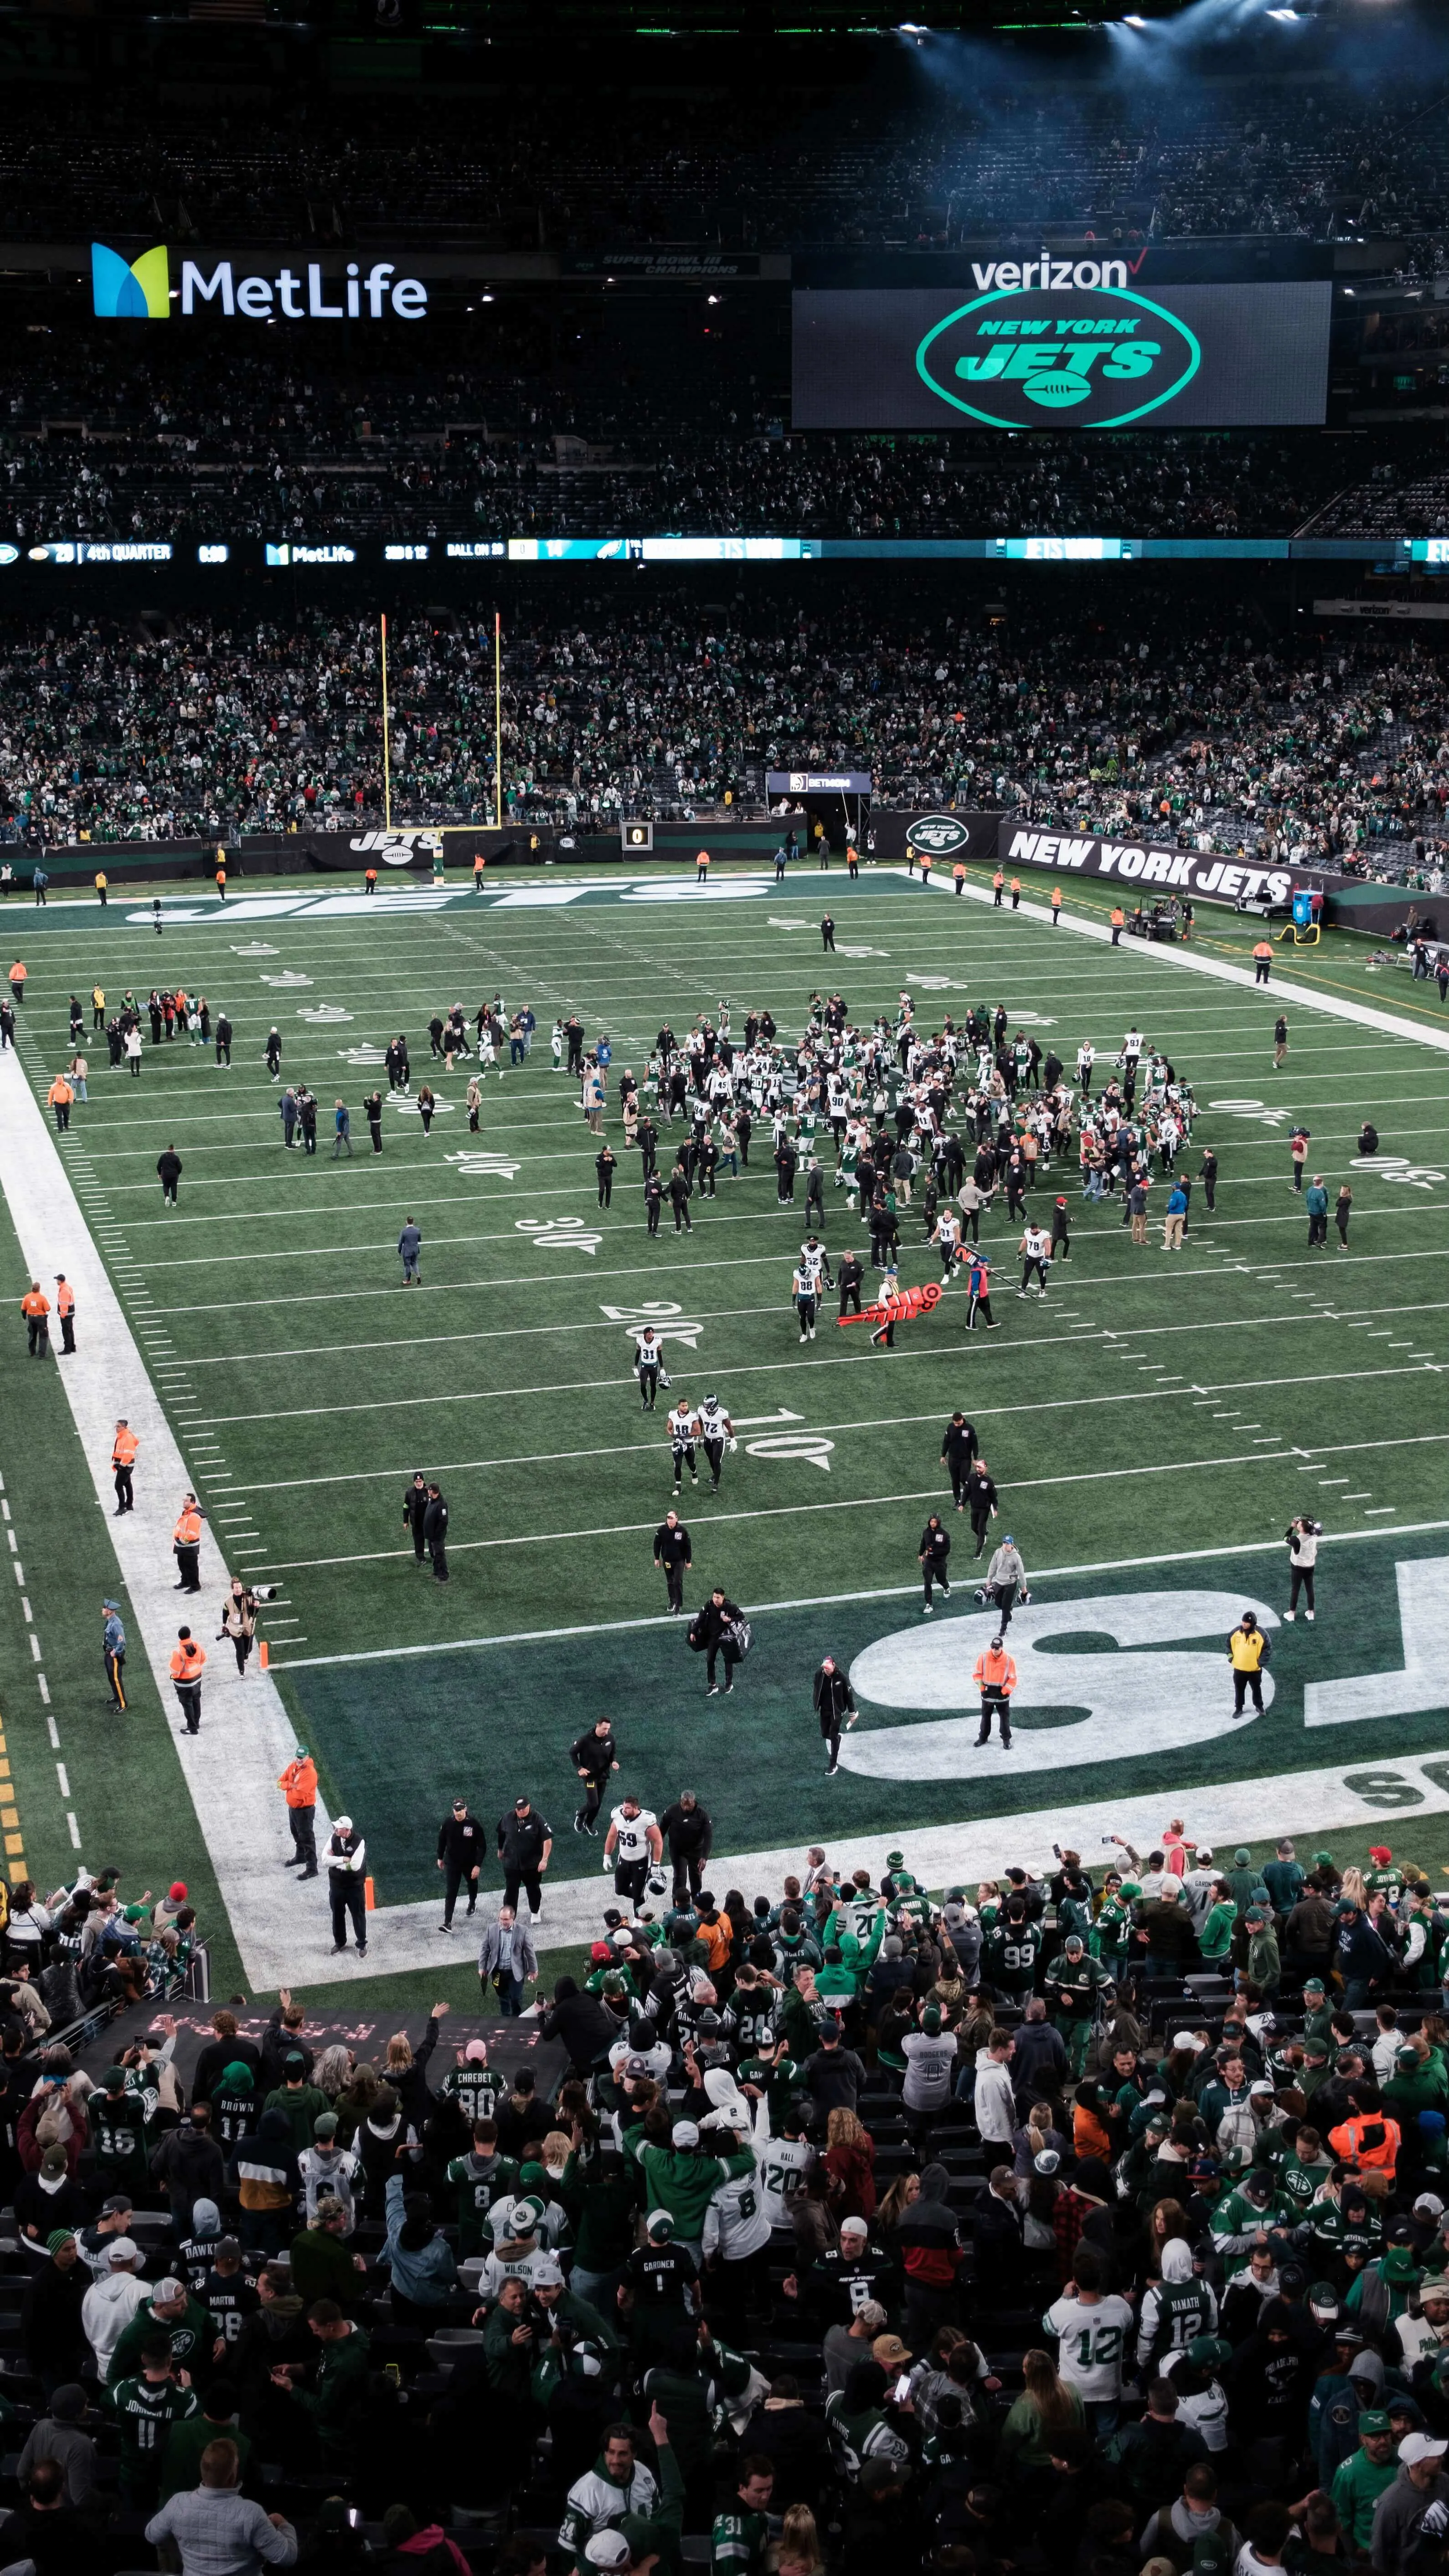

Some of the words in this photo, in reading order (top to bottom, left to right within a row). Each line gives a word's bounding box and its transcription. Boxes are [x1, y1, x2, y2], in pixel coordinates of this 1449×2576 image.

[603, 256, 653, 264] SUPER
[656, 256, 701, 264] BOWL
[703, 256, 722, 264] III
[645, 265, 738, 274] CHAMPIONS
[971, 253, 1127, 290] verizon
[182, 261, 427, 318] MetLife
[977, 320, 1052, 335] NEW
[1055, 319, 1140, 335] YORK
[955, 341, 1161, 380] JETS
[87, 546, 110, 560] 4th
[113, 545, 171, 560] QUARTER
[293, 547, 354, 562] MetLife
[448, 544, 473, 556] BALL
[350, 831, 444, 851] JETS
[632, 828, 643, 844] 0
[915, 830, 960, 841] JETS
[1008, 831, 1096, 867] NEW
[1098, 843, 1197, 886] YORK
[1196, 862, 1291, 902] JETS
[125, 880, 777, 923] JETS
[258, 974, 314, 987] 20
[297, 1007, 354, 1022] 30
[832, 1096, 844, 1106] 90
[443, 1151, 521, 1174] 40
[842, 1149, 856, 1161] 77
[1350, 1156, 1447, 1182] 30
[515, 1217, 603, 1247] 30
[1028, 1241, 1039, 1251] 78
[955, 1247, 973, 1262] 2
[800, 1281, 812, 1291] 88
[598, 1301, 704, 1339] 20
[643, 1349, 654, 1359] 31
[704, 1422, 717, 1434] 72
[618, 1830, 637, 1848] 69
[900, 1900, 922, 1910] NAMATH
[1004, 1944, 1034, 1970] 99
[458, 2073, 491, 2084] CHREBET
[221, 2100, 254, 2112] BROWN
[459, 2088, 495, 2119] 80
[730, 2107, 738, 2117] 2
[221, 2117, 247, 2142] 11
[100, 2127, 135, 2154] 16
[780, 2152, 794, 2163] HALL
[767, 2164, 803, 2195] 20
[474, 2185, 490, 2209] 8
[738, 2188, 757, 2220] 8
[504, 2264, 532, 2276] WILSON
[644, 2260, 675, 2272] GARDNER
[656, 2274, 664, 2292] 1
[210, 2296, 235, 2306] MARTIN
[850, 2282, 870, 2315] 8
[1171, 2296, 1200, 2312] NAMATH
[1170, 2313, 1202, 2348] 12
[1077, 2326, 1122, 2366] 12
[138, 2418, 155, 2449] 11
[832, 2416, 850, 2440] HARRIS
